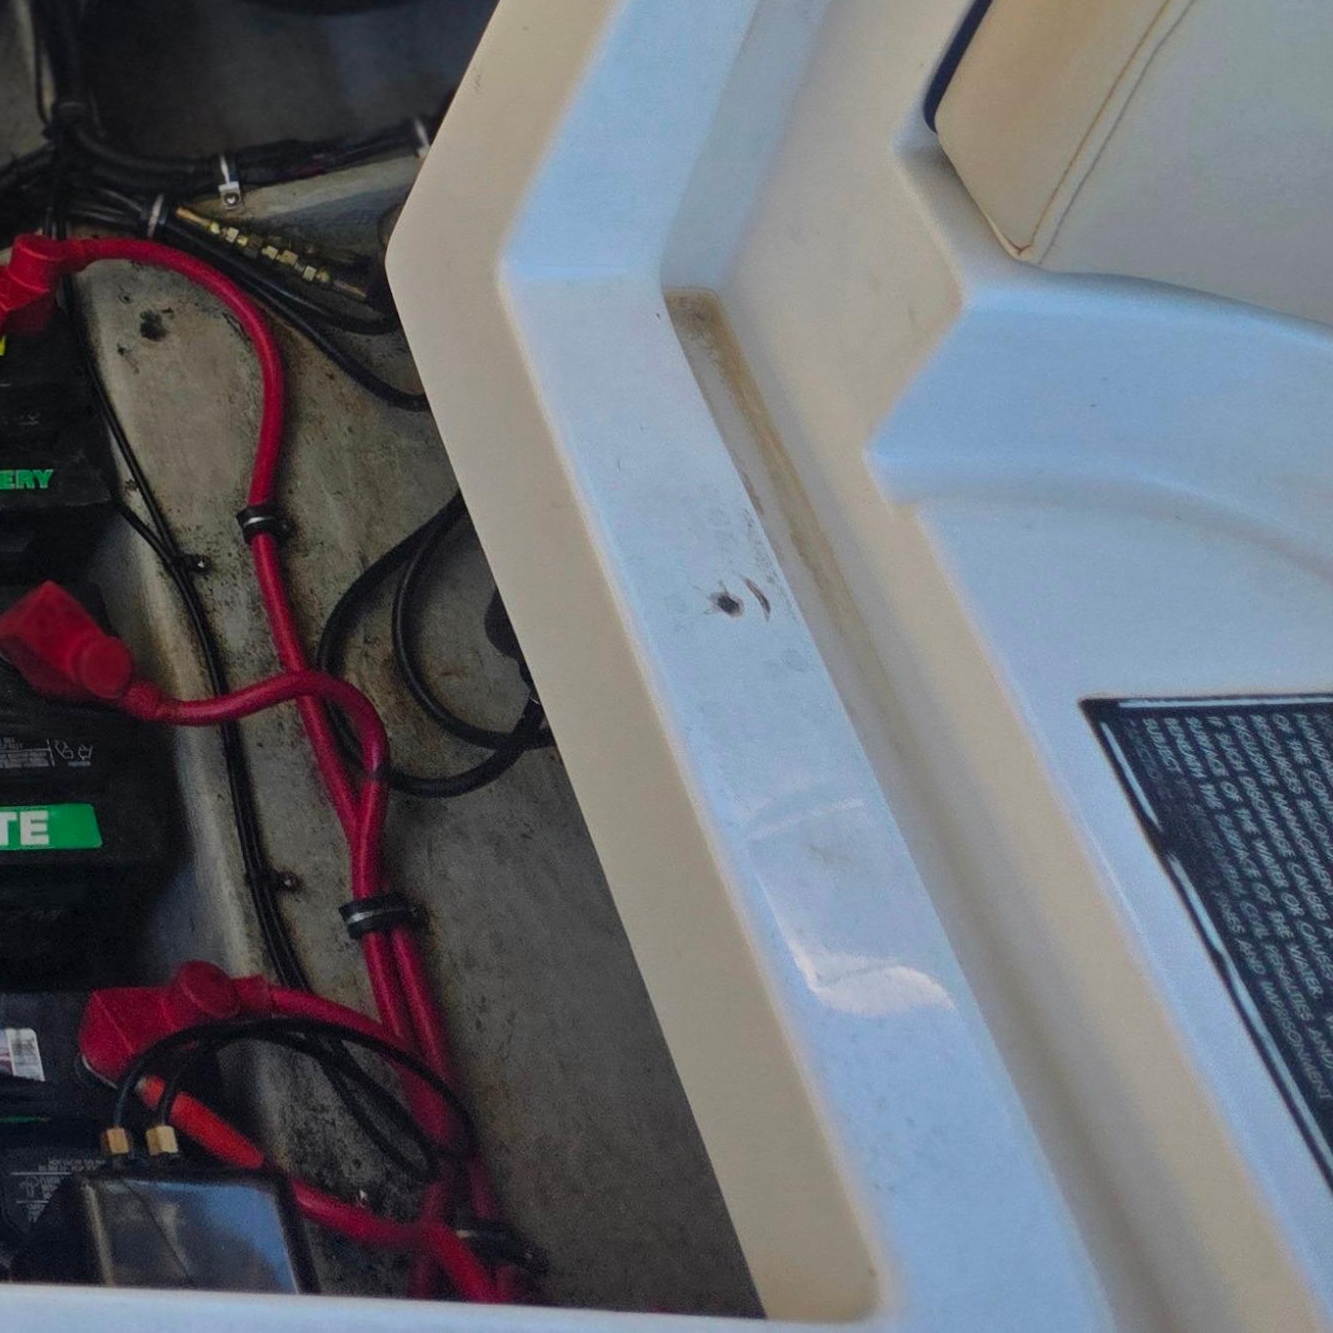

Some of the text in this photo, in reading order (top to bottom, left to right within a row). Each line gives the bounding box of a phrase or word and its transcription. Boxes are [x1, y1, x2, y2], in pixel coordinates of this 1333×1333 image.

[1161, 716, 1208, 778] BENEATH
[1197, 784, 1225, 808] THE
[1212, 814, 1262, 877] SURFACE
[1249, 882, 1277, 904] OF
[1264, 910, 1295, 938] THE
[1183, 716, 1230, 776] SURFACE
[1218, 780, 1245, 802] OF
[1232, 808, 1262, 834] THE
[1250, 838, 1292, 887] WATER
[1278, 892, 1307, 916] OR
[1213, 732, 1248, 770] SUCH
[1238, 776, 1297, 857] DISCHARGE
[1284, 862, 1332, 920] CAUSES
[1226, 715, 1279, 786] EXCLUSIVE
[1248, 714, 1307, 794] RESOURCES
[1140, 717, 1183, 772] SUBJECT
[1237, 900, 1273, 938] CIVIL
[1261, 944, 1317, 1020] PENALTIES
[1235, 939, 1269, 974] AND
[1256, 980, 1333, 1099] IMPRISONMENT
